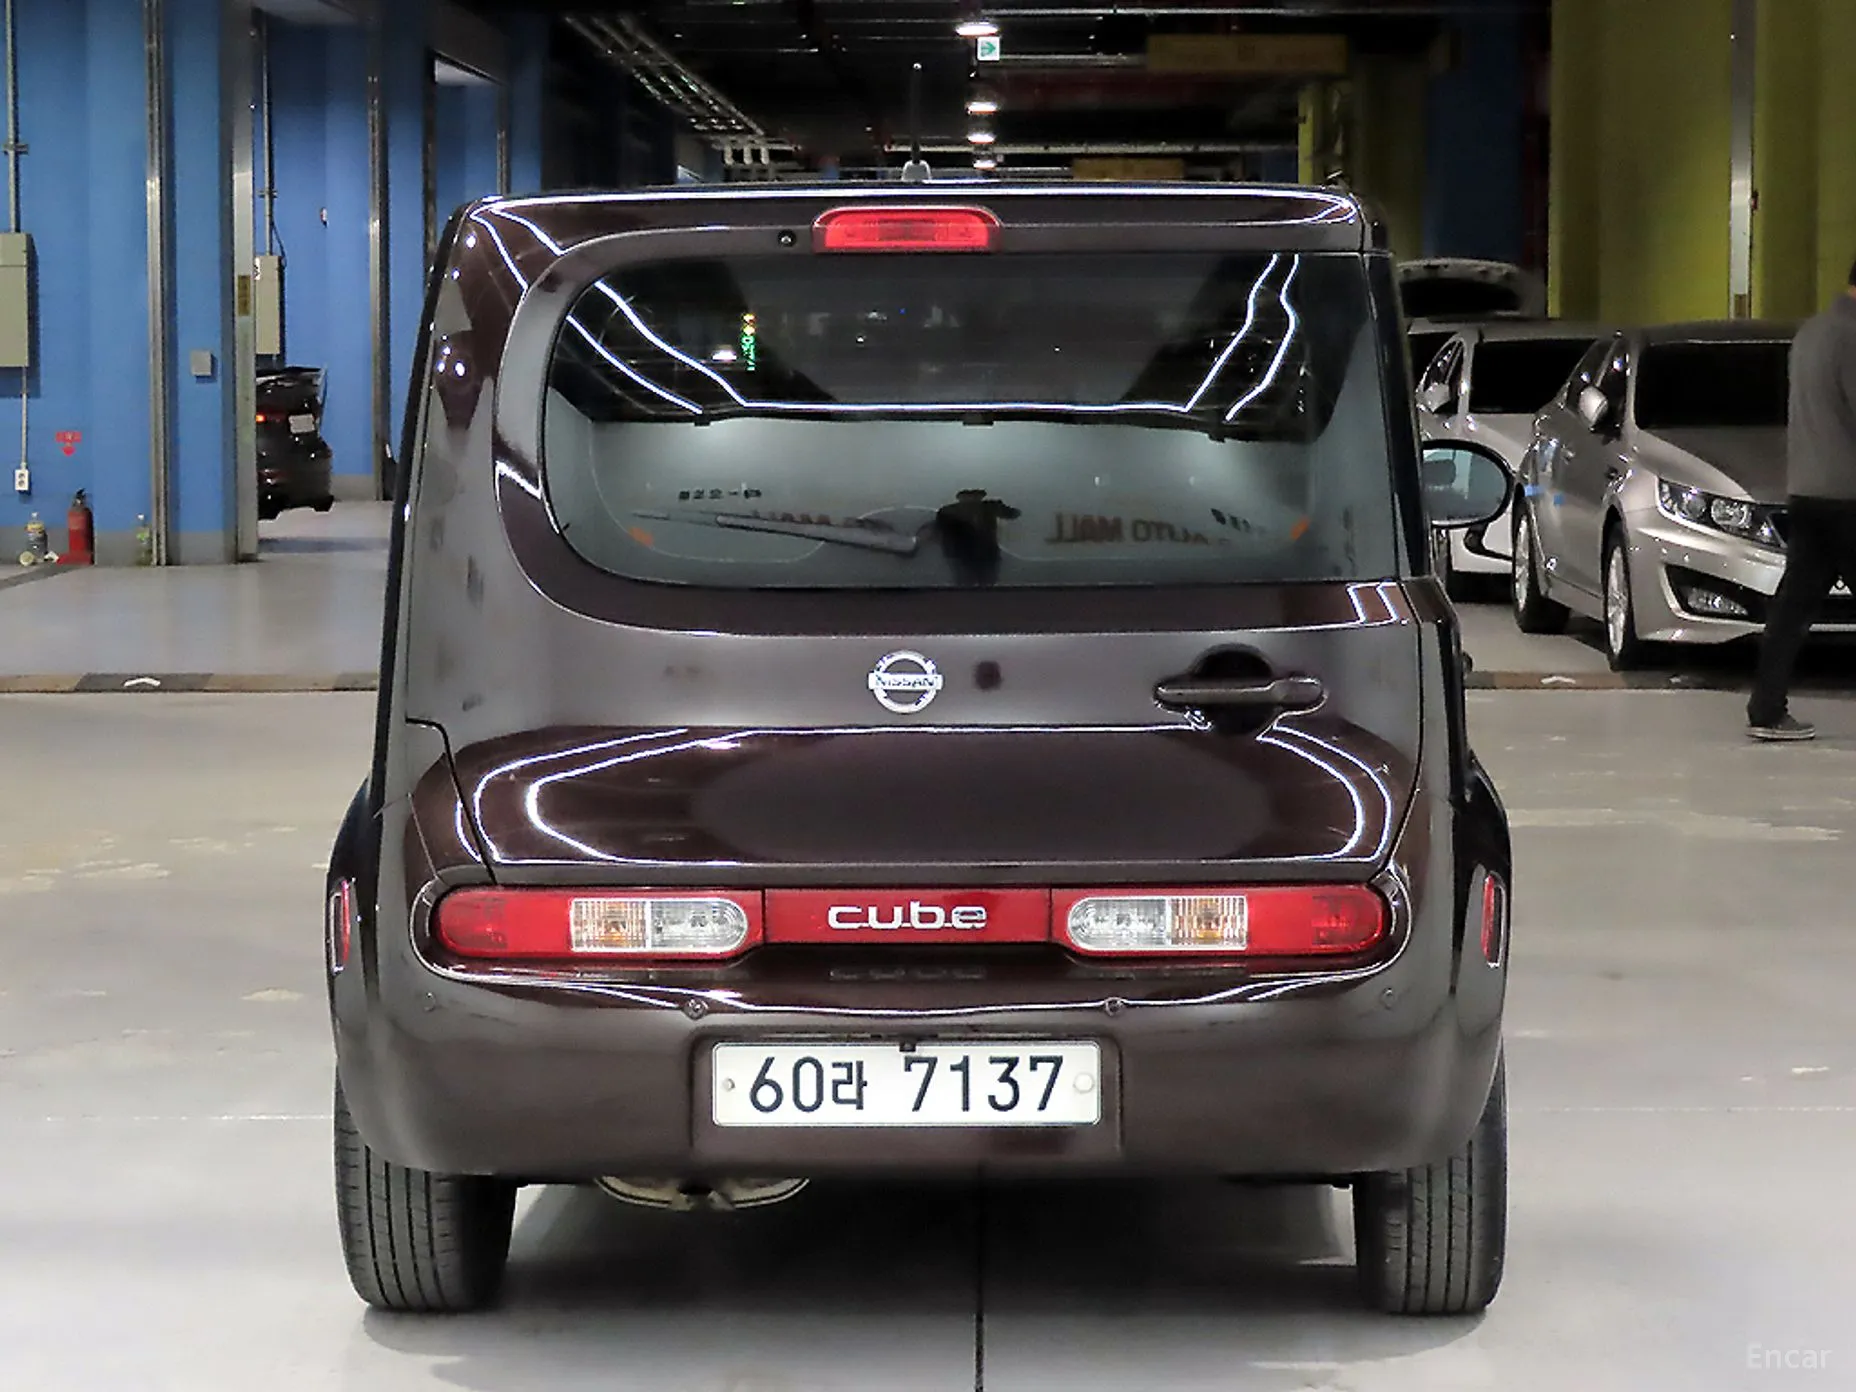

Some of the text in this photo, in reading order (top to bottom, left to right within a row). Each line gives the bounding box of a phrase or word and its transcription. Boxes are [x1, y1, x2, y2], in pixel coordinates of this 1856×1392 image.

[874, 673, 938, 689] NISSAN
[828, 901, 987, 929] cube
[749, 1054, 1064, 1113] 60라 7137
